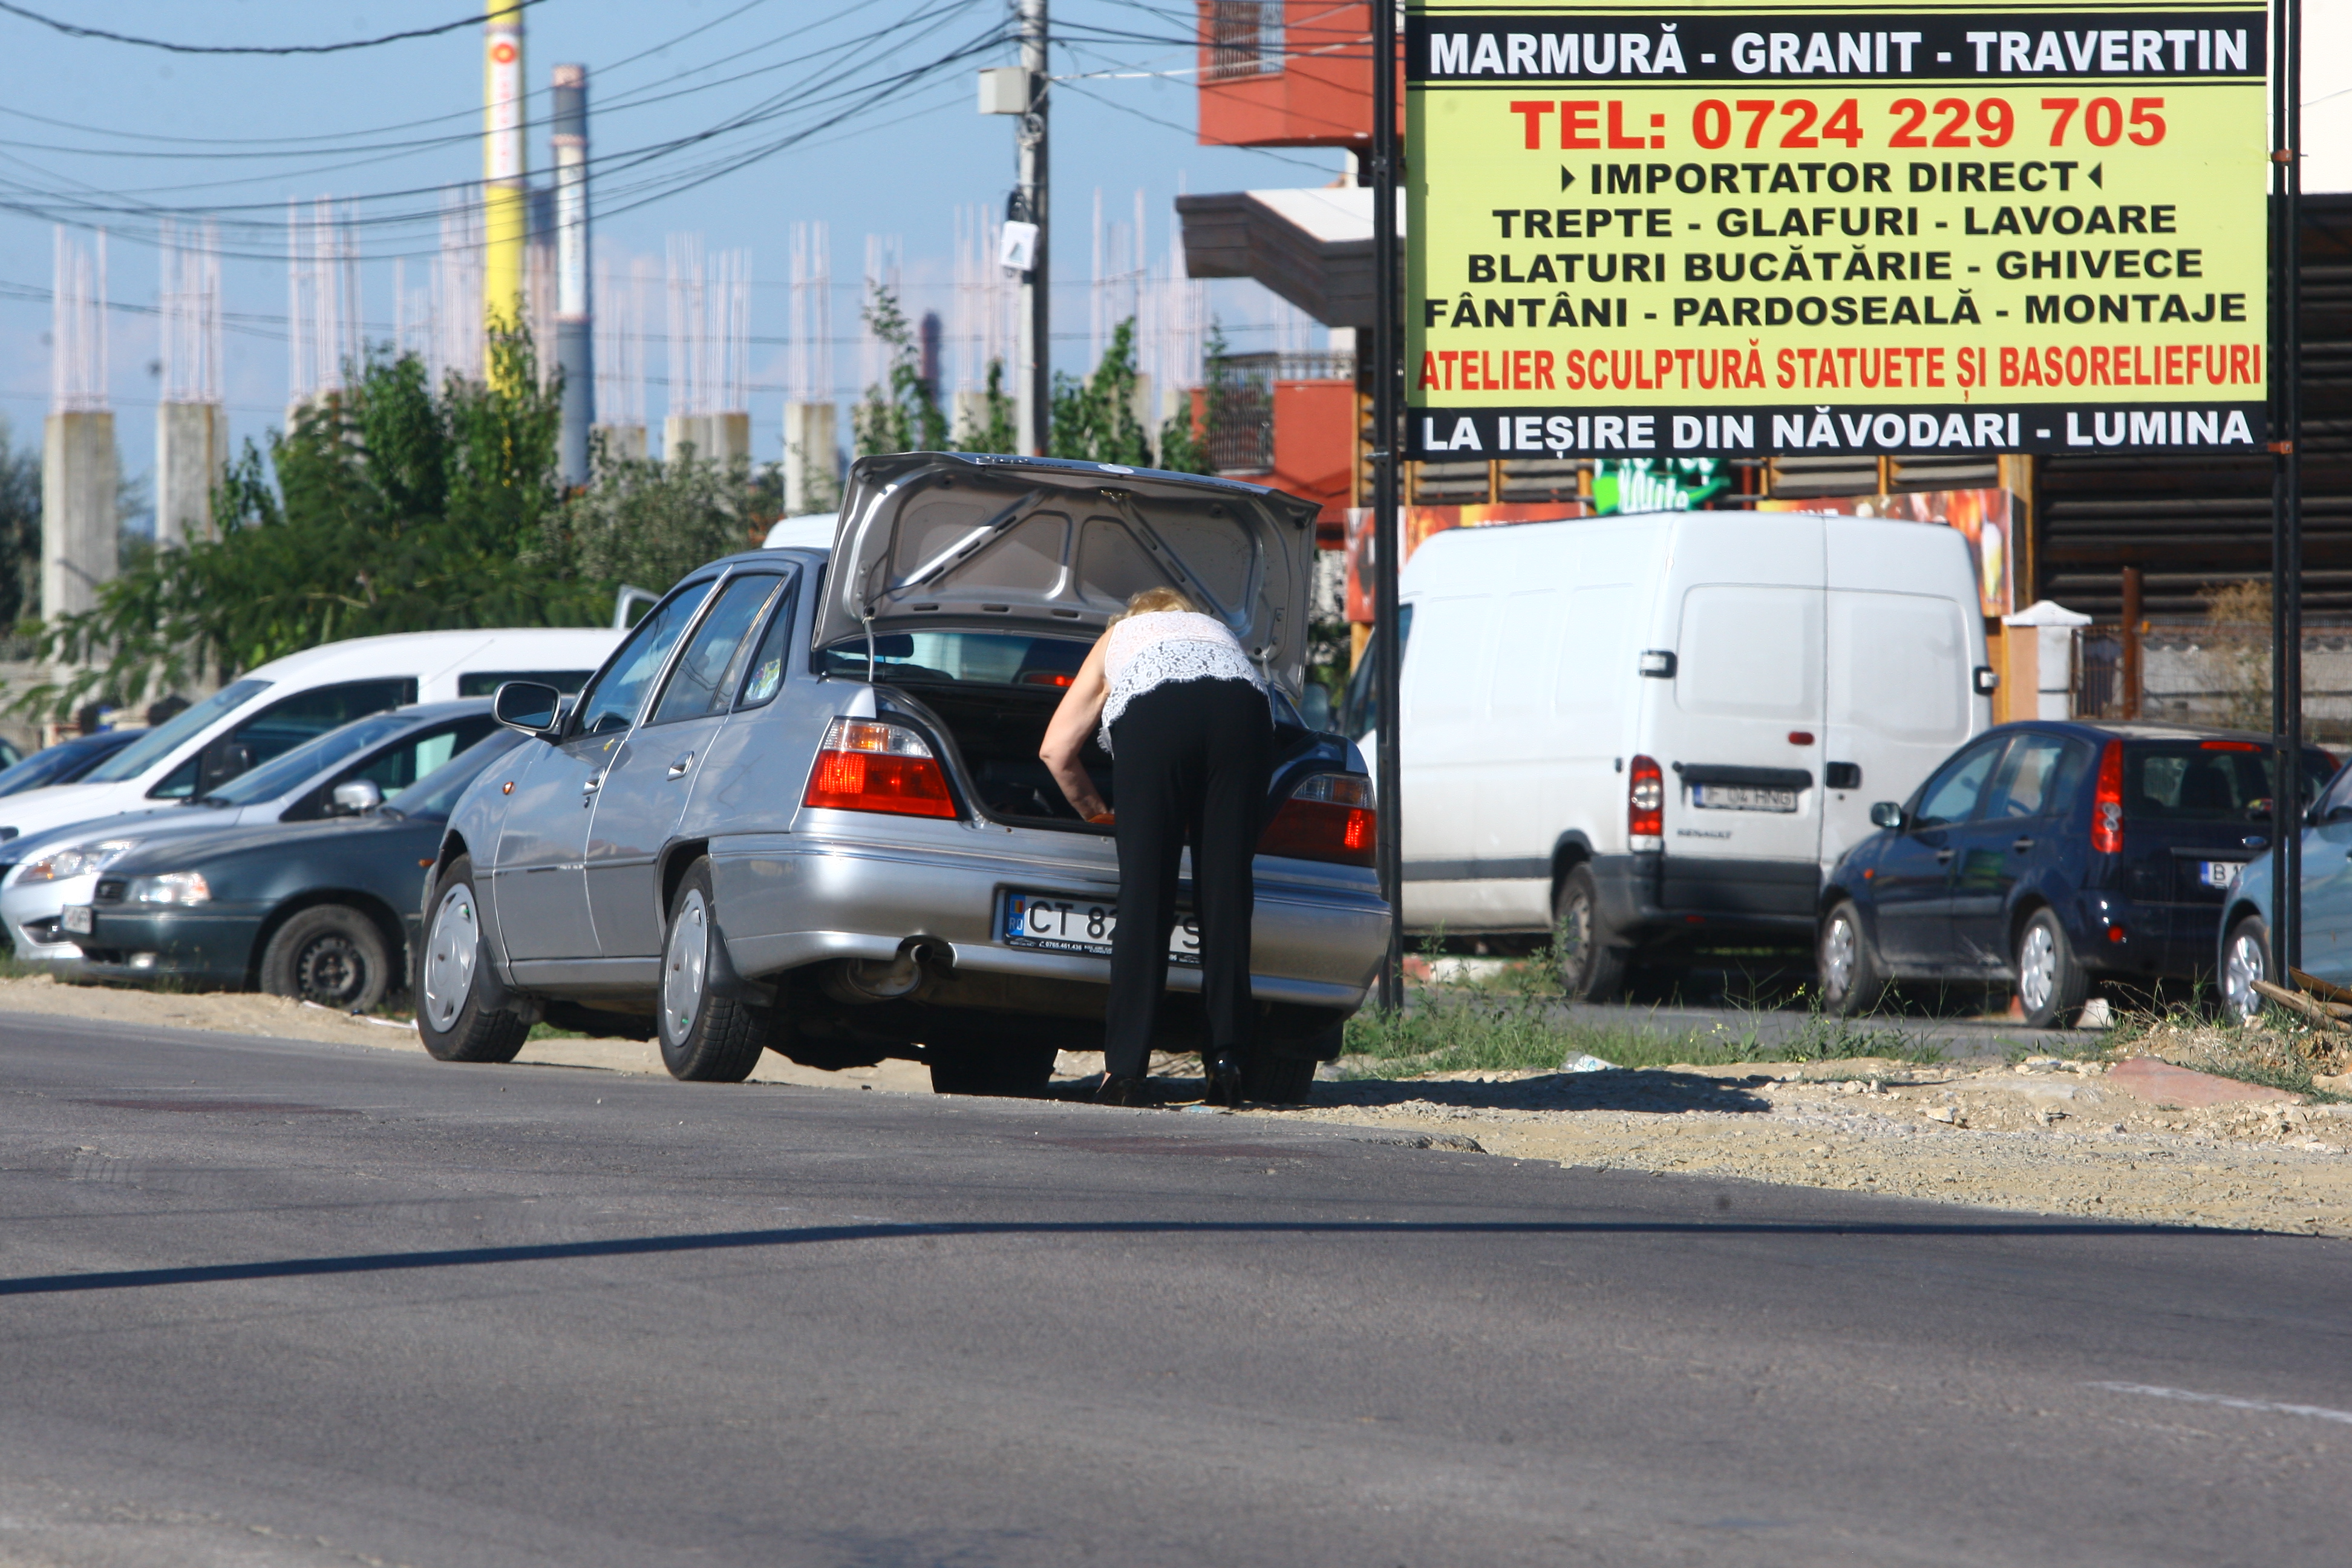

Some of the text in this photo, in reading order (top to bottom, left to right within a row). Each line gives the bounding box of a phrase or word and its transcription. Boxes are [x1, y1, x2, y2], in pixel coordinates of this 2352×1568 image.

[1430, 22, 1687, 74] MARMURĂ
[1731, 31, 1922, 74] GRANIT
[1966, 29, 2247, 72] TRAVERTIN
[1510, 97, 2166, 149] TEL: 0724 229 705
[1592, 161, 2079, 195] IMPORTATOR DIRECT
[1492, 208, 1672, 238] TREPTE
[1717, 207, 1918, 238] GLAFURI
[1964, 204, 2177, 235] LAVOARE
[1468, 253, 1665, 283] BLATURI
[1685, 244, 1952, 282] BUCĂTĂRIE
[1996, 249, 2203, 280] GHIVECE
[1425, 291, 1627, 328] FÂNTÂNI
[1674, 289, 1981, 327] PARDOSEALĂ
[2025, 293, 2247, 323] MONTAJE
[1418, 339, 2261, 402] ATELIER SCULPTURĂ STATUETE ȘI BASORELIEFURI
[1422, 416, 1483, 451] LA
[1498, 415, 1655, 459] IEȘIRE
[1672, 414, 1756, 449] DIN
[1772, 406, 2020, 449] NĂVODARI
[2066, 411, 2254, 446] LUMINA
[1028, 900, 1074, 936] CT
